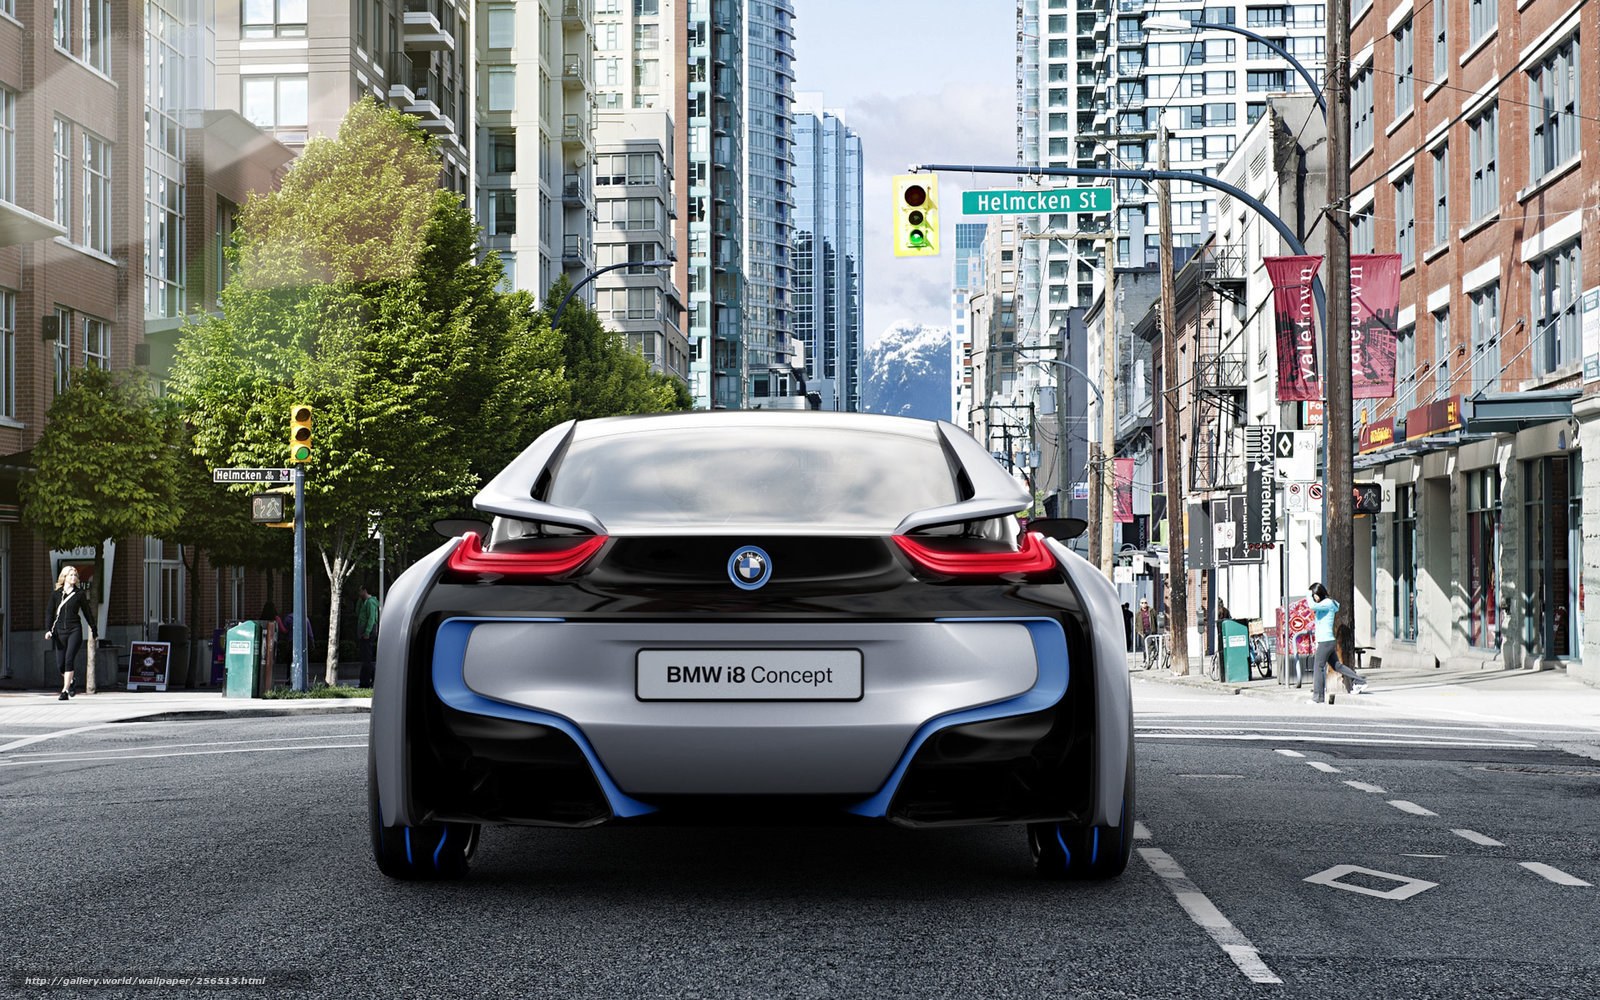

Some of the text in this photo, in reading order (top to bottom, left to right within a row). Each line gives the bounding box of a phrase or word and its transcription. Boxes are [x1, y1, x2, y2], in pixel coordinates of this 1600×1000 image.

[978, 191, 1097, 211] Helmcken St
[1296, 267, 1315, 380] yaletown
[1261, 426, 1275, 461] Book
[216, 470, 262, 480] Helmcken
[1261, 463, 1275, 542] Warehouse
[667, 665, 833, 686] BMW i8 Concept
